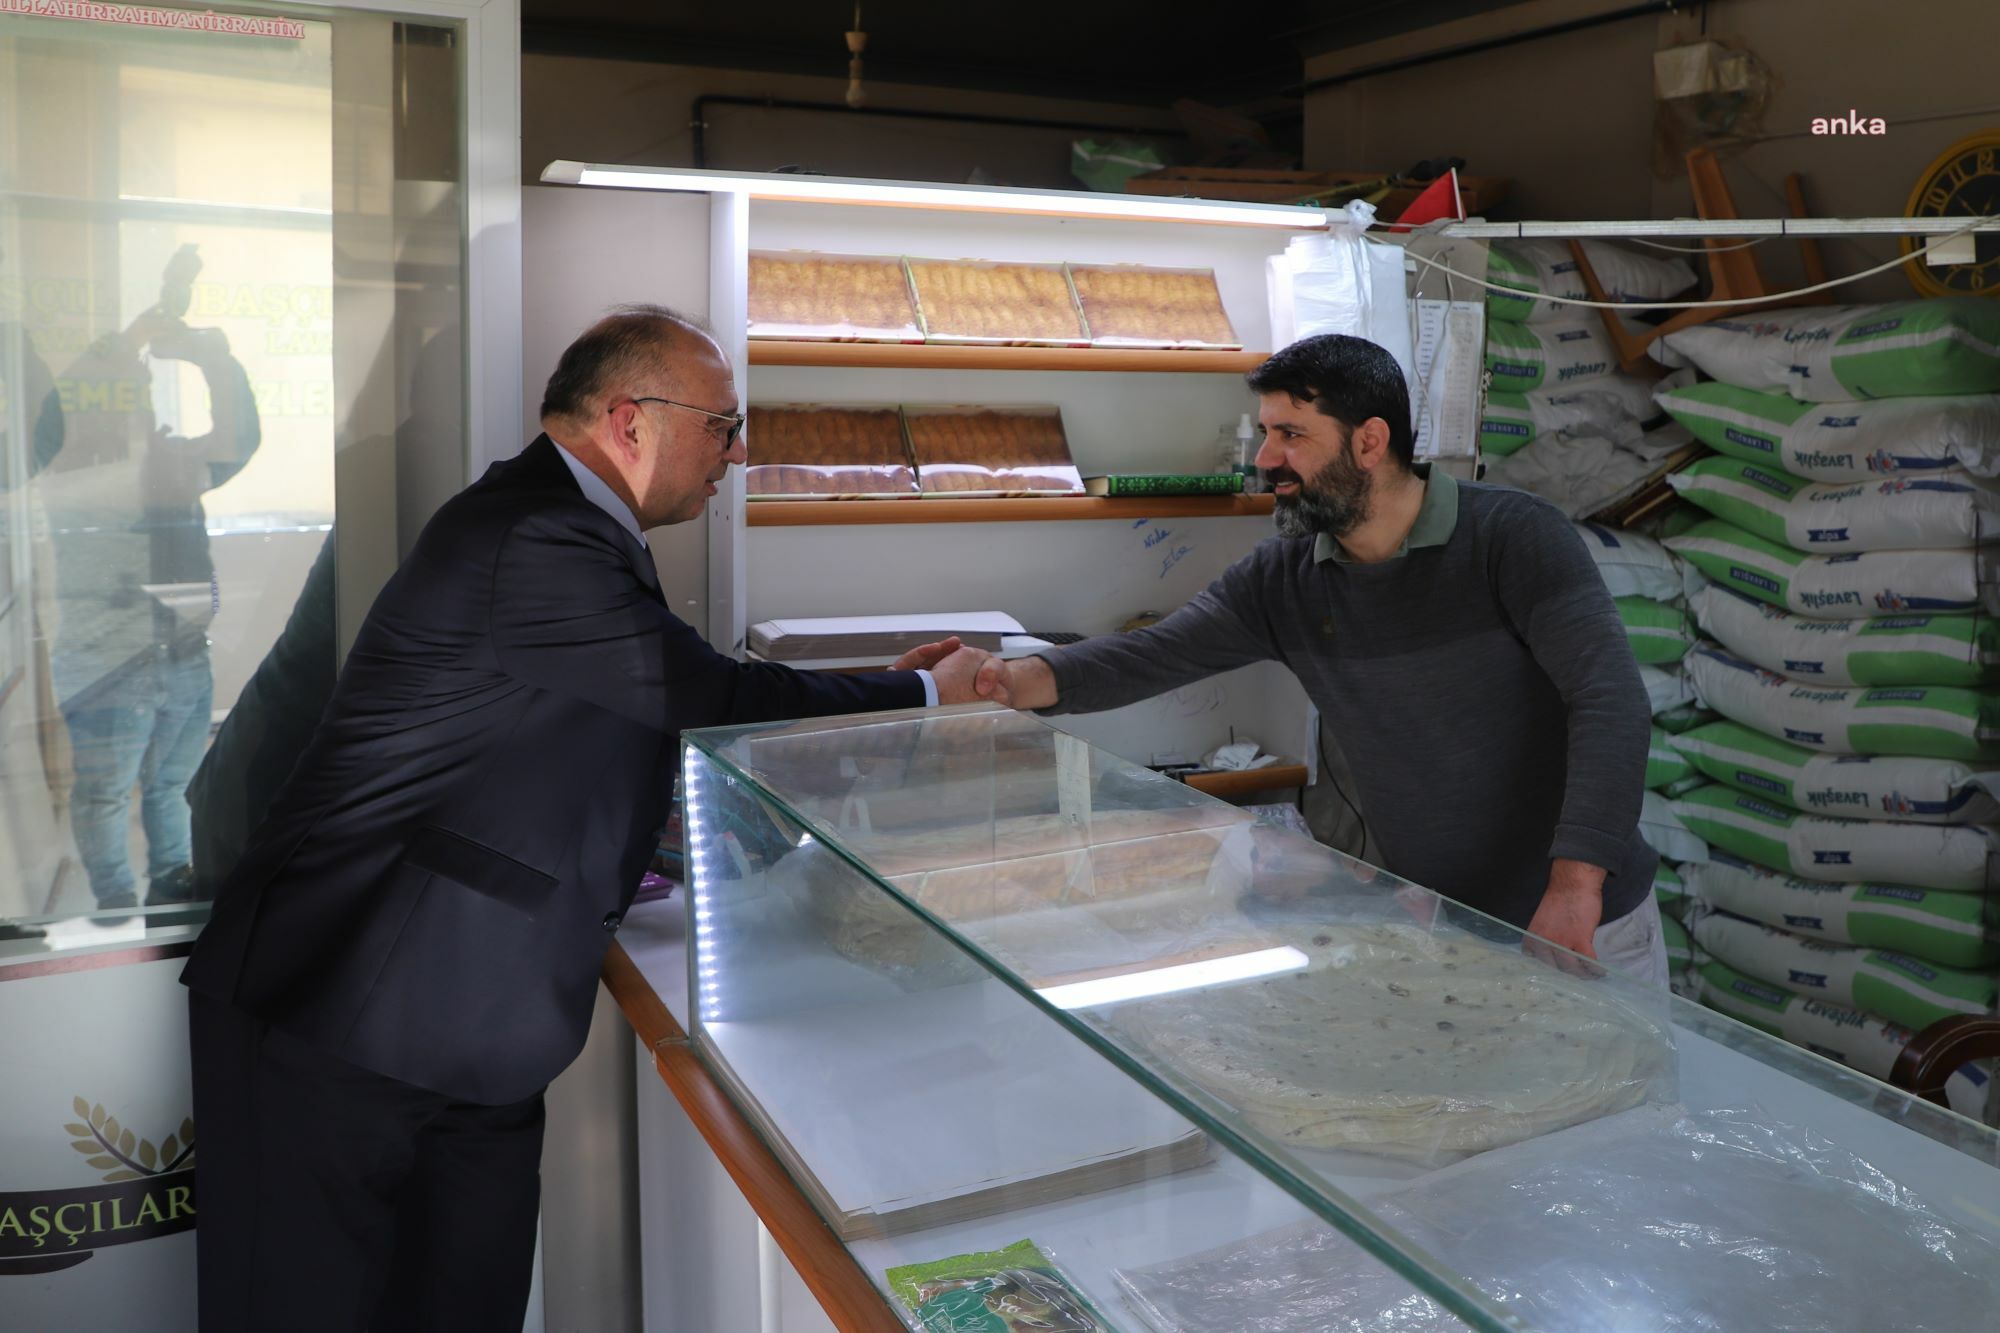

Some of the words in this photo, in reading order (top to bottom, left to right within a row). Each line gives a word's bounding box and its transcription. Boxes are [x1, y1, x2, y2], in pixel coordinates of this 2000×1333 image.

[1794, 450, 1854, 470] Lavaşlık
[1799, 591, 1863, 608] Lavaşlık
[1807, 789, 1868, 807] Lavaşlık
[1803, 998, 1867, 1028] Lavaşlık
[0, 1186, 197, 1248] AŞÇILAR
